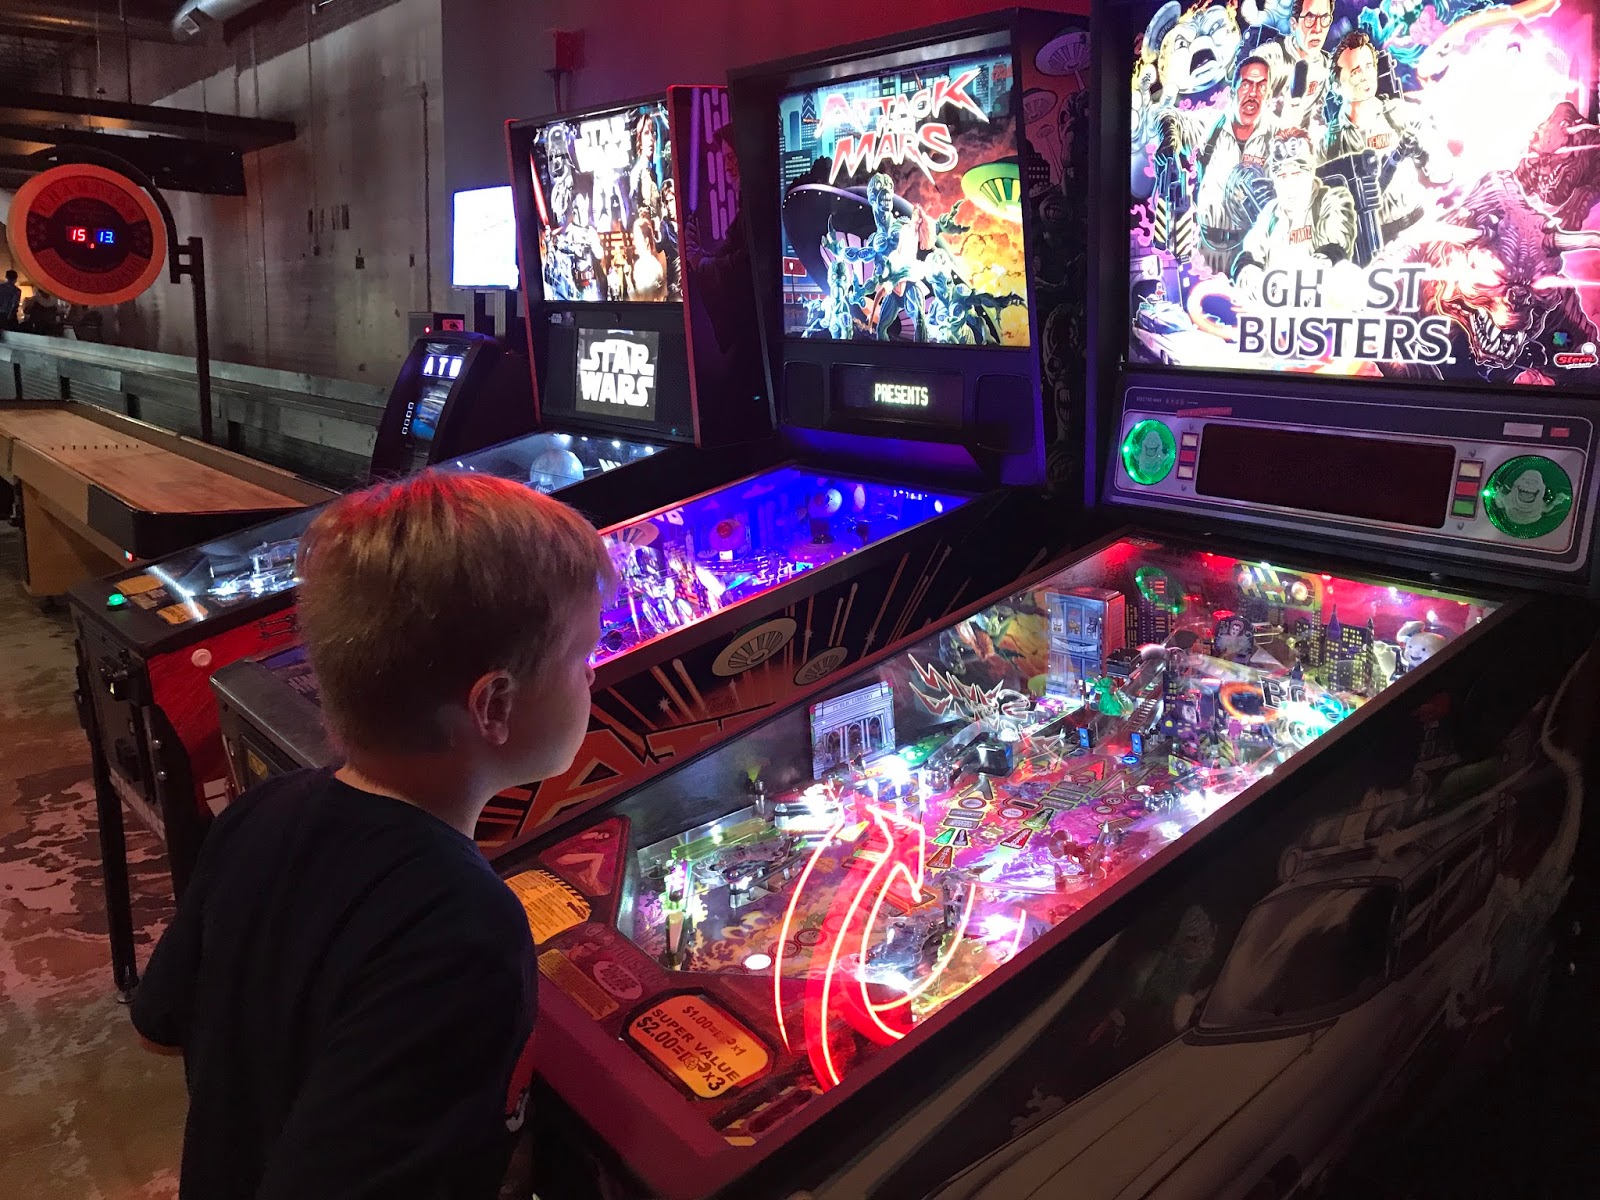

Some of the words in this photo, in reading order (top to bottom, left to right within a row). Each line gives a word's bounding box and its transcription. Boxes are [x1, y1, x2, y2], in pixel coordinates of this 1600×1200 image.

[814, 67, 990, 138] ATTACK
[829, 123, 958, 185] MARS
[72, 229, 86, 241] 15
[1262, 267, 1426, 309] GHST
[580, 339, 655, 376] STAR
[1238, 315, 1451, 363] BUSTERS
[1558, 354, 1594, 364] Stern
[580, 371, 654, 407] WARS
[874, 383, 929, 407] PRESENTS
[651, 1008, 695, 1043] SUPER
[694, 1041, 741, 1082] VALUE
